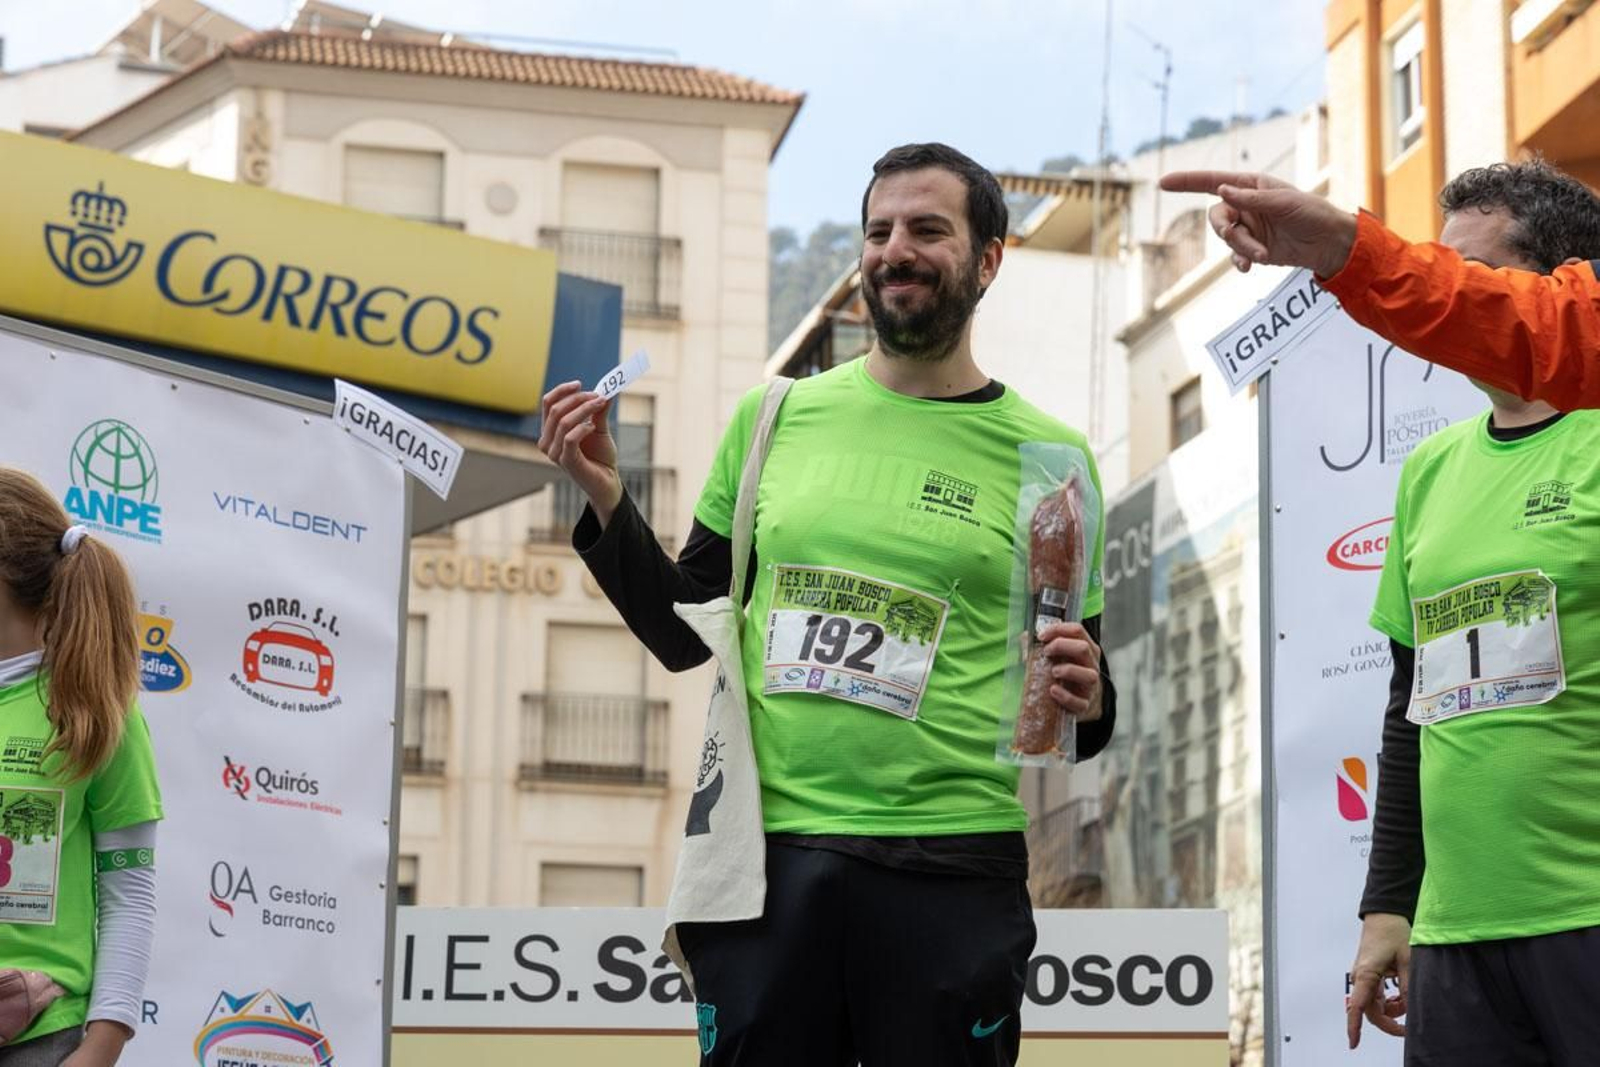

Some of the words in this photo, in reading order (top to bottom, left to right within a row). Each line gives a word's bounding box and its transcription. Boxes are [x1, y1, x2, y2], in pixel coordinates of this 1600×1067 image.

[156, 231, 499, 365] CORREOS
[1225, 278, 1323, 374] ¡GRACIA
[603, 371, 626, 396] 192
[340, 397, 448, 477] ¡GRACIAS!
[64, 487, 162, 536] ANPE
[213, 491, 368, 543] VITALDENT
[415, 555, 562, 597] COLEGIO
[804, 572, 824, 589] SAN
[825, 574, 856, 593] JUAN
[857, 581, 893, 602] BOSCO
[1474, 581, 1501, 601] BOSCO
[834, 592, 879, 614] POPULAR
[1460, 599, 1494, 625] POPULAR
[798, 614, 885, 674] 192
[1466, 628, 1481, 680] 1
[281, 701, 297, 712] del
[255, 765, 320, 798] Quirós
[269, 884, 337, 909] Gestoria
[262, 909, 336, 934] Barranco
[402, 934, 578, 1003] I.E.S.
[593, 935, 695, 1003] Sa
[1024, 954, 1214, 1006] osco
